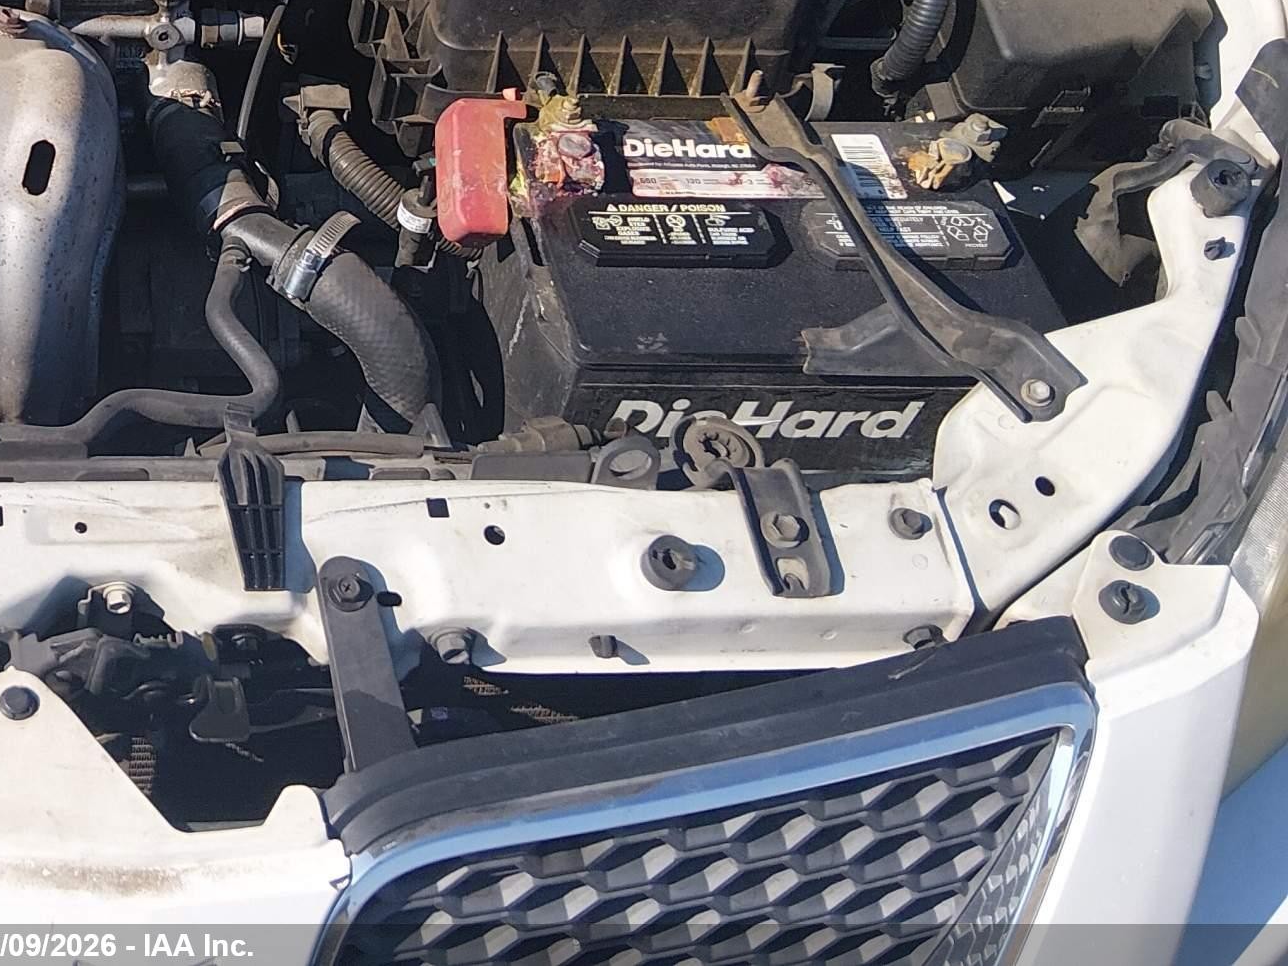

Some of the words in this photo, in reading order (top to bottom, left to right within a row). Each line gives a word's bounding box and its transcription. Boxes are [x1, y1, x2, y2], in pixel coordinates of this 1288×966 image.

[623, 138, 753, 159] DieHard
[618, 204, 669, 212] DANGER
[680, 204, 726, 212] POISON
[612, 398, 926, 438] DiHard
